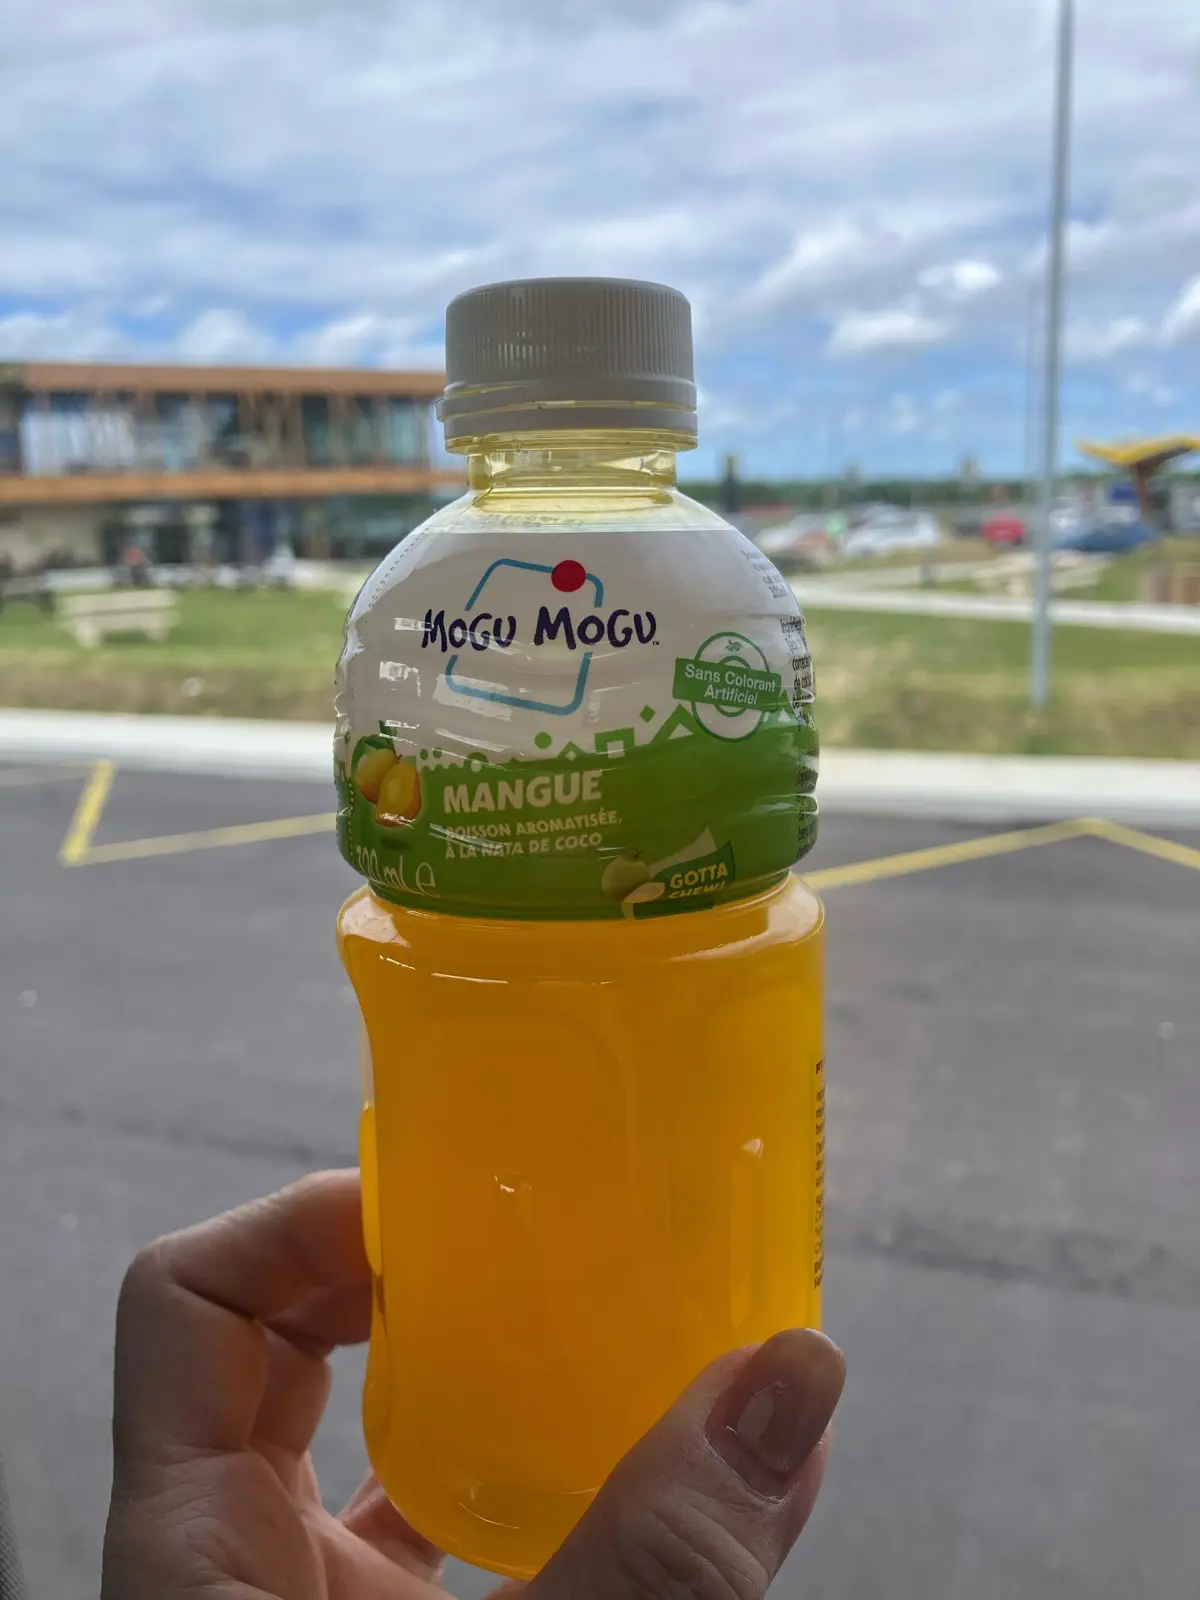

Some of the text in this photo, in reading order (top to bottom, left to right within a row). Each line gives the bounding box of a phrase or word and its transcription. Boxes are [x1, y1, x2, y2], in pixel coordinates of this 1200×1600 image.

[421, 608, 517, 652] MOGU
[534, 605, 657, 651] MOGU
[684, 663, 776, 693] Sans Colorant
[703, 684, 759, 705] Artificiel
[443, 769, 603, 814] MANGUE
[459, 844, 477, 859] LA
[529, 838, 550, 854] DE
[554, 832, 603, 850] COCO
[669, 862, 729, 889] GOTTA
